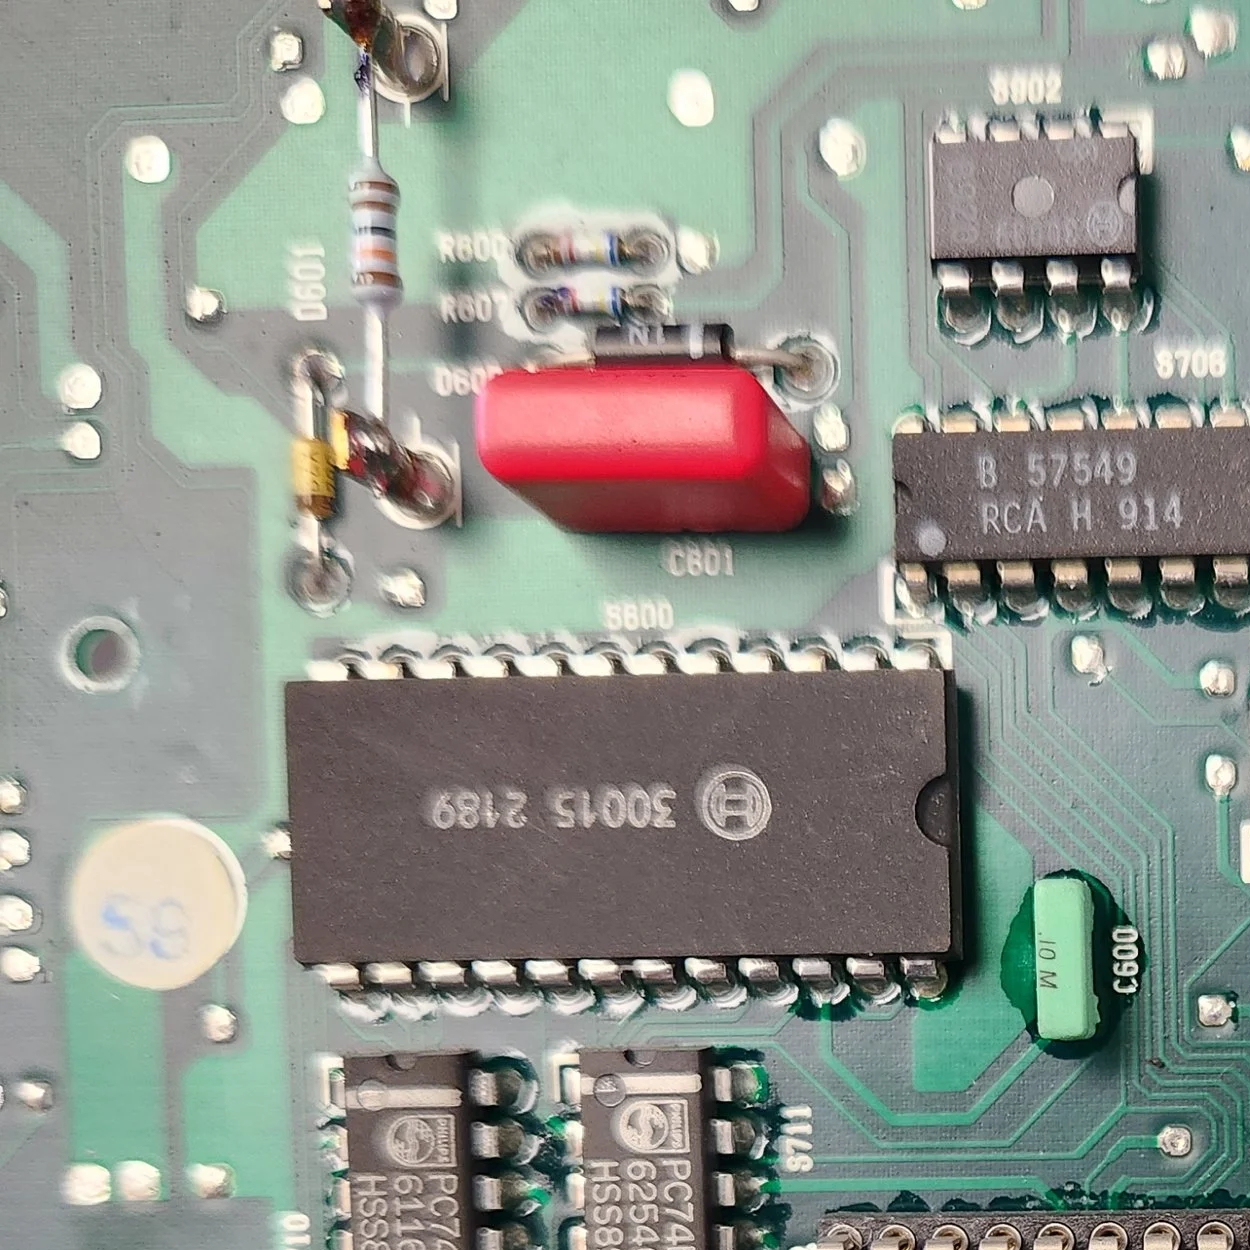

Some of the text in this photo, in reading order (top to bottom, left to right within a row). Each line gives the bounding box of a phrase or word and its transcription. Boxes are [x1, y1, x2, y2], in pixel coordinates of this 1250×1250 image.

[976, 451, 1138, 489] B 57549
[981, 498, 1184, 534] RCA H 914
[430, 787, 678, 831] 30015 2189
[1112, 925, 1140, 995] C600
[780, 1103, 814, 1173] S711
